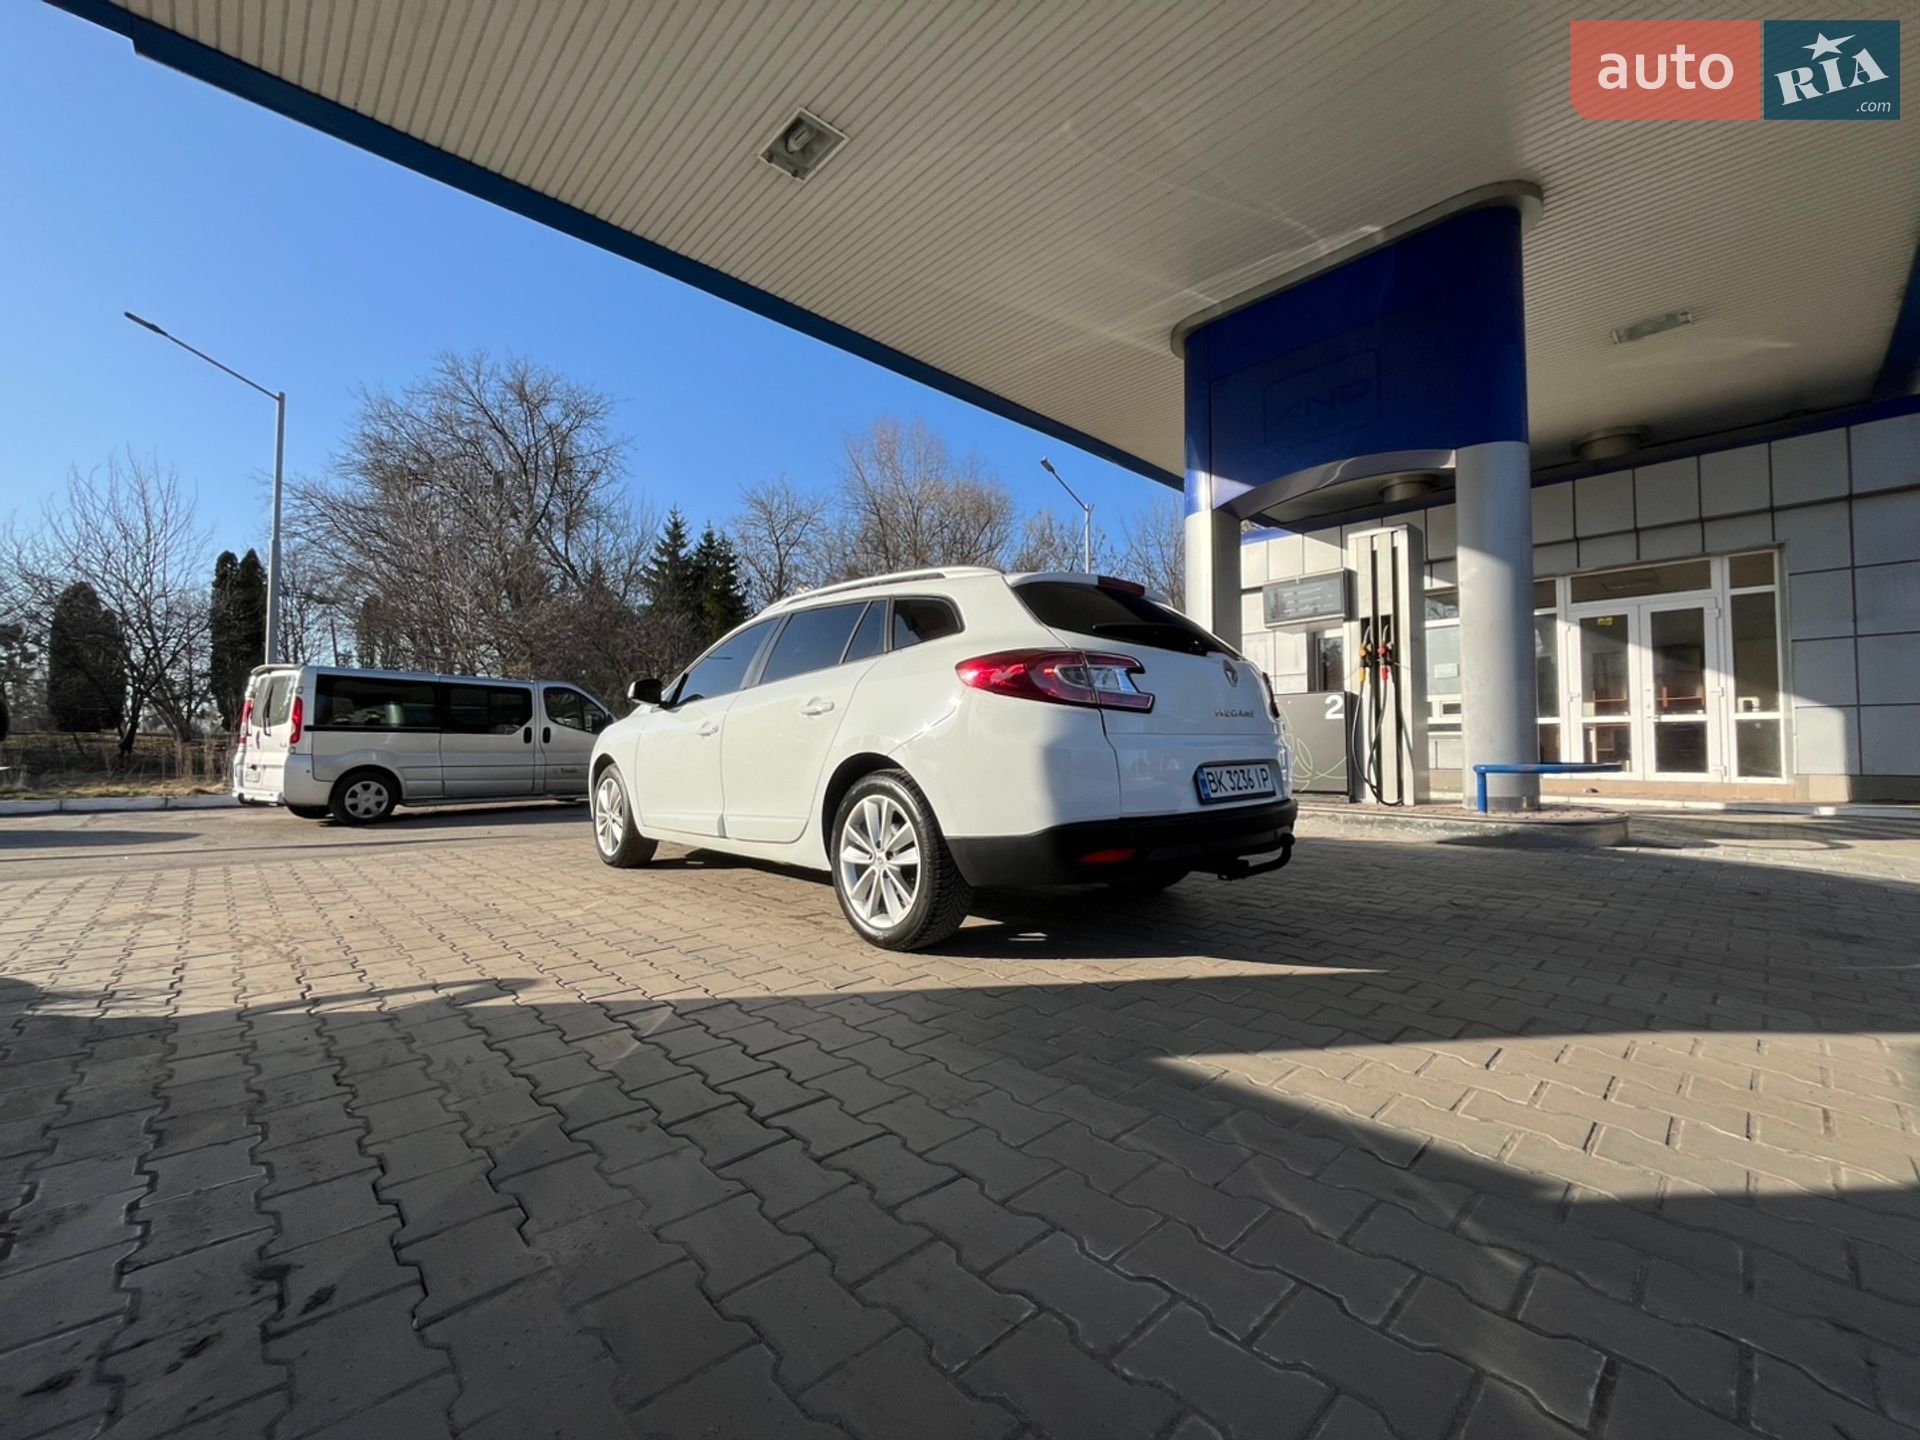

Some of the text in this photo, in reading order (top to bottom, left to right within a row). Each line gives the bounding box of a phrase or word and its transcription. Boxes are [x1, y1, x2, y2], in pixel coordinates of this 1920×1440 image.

[1325, 694, 1344, 720] 2
[1206, 771, 1228, 793] BK
[1226, 768, 1255, 791] 3236
